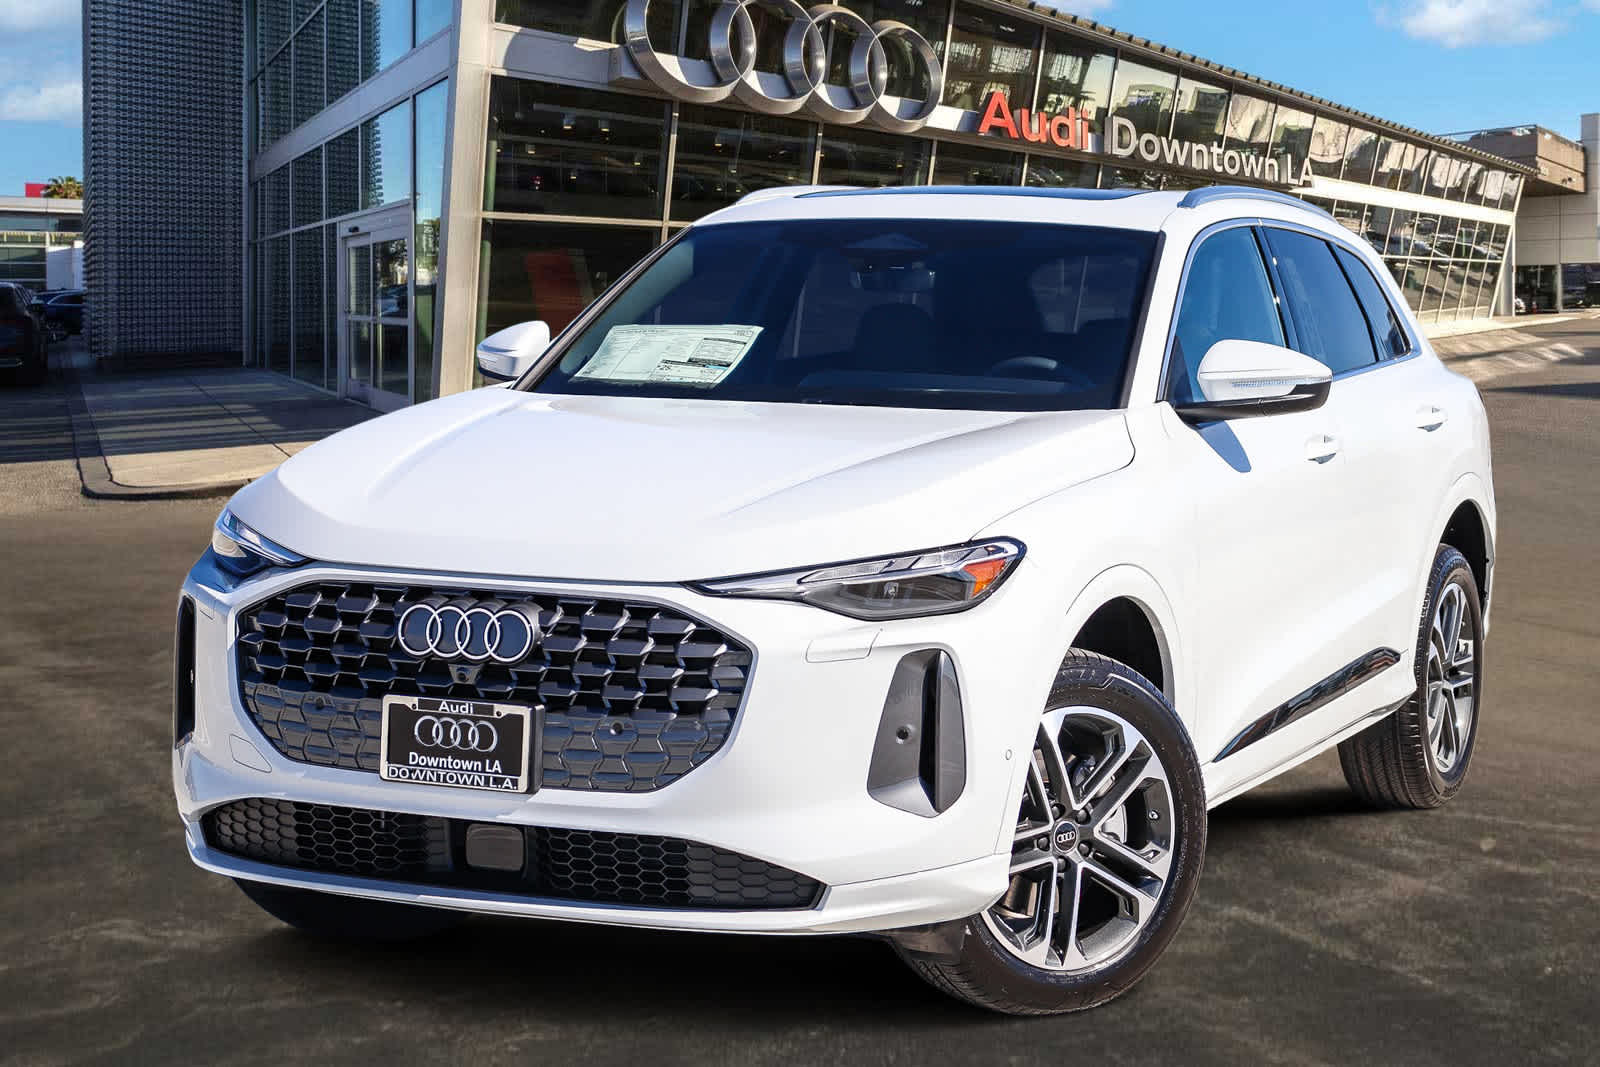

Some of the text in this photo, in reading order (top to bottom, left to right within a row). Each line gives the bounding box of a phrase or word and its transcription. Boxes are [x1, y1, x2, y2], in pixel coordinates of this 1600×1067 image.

[978, 91, 1315, 187] Audi Downtown LA
[438, 700, 474, 714] Audi
[409, 751, 502, 773] Downtown LA
[388, 766, 518, 790] DOWNTOWN L.A.
